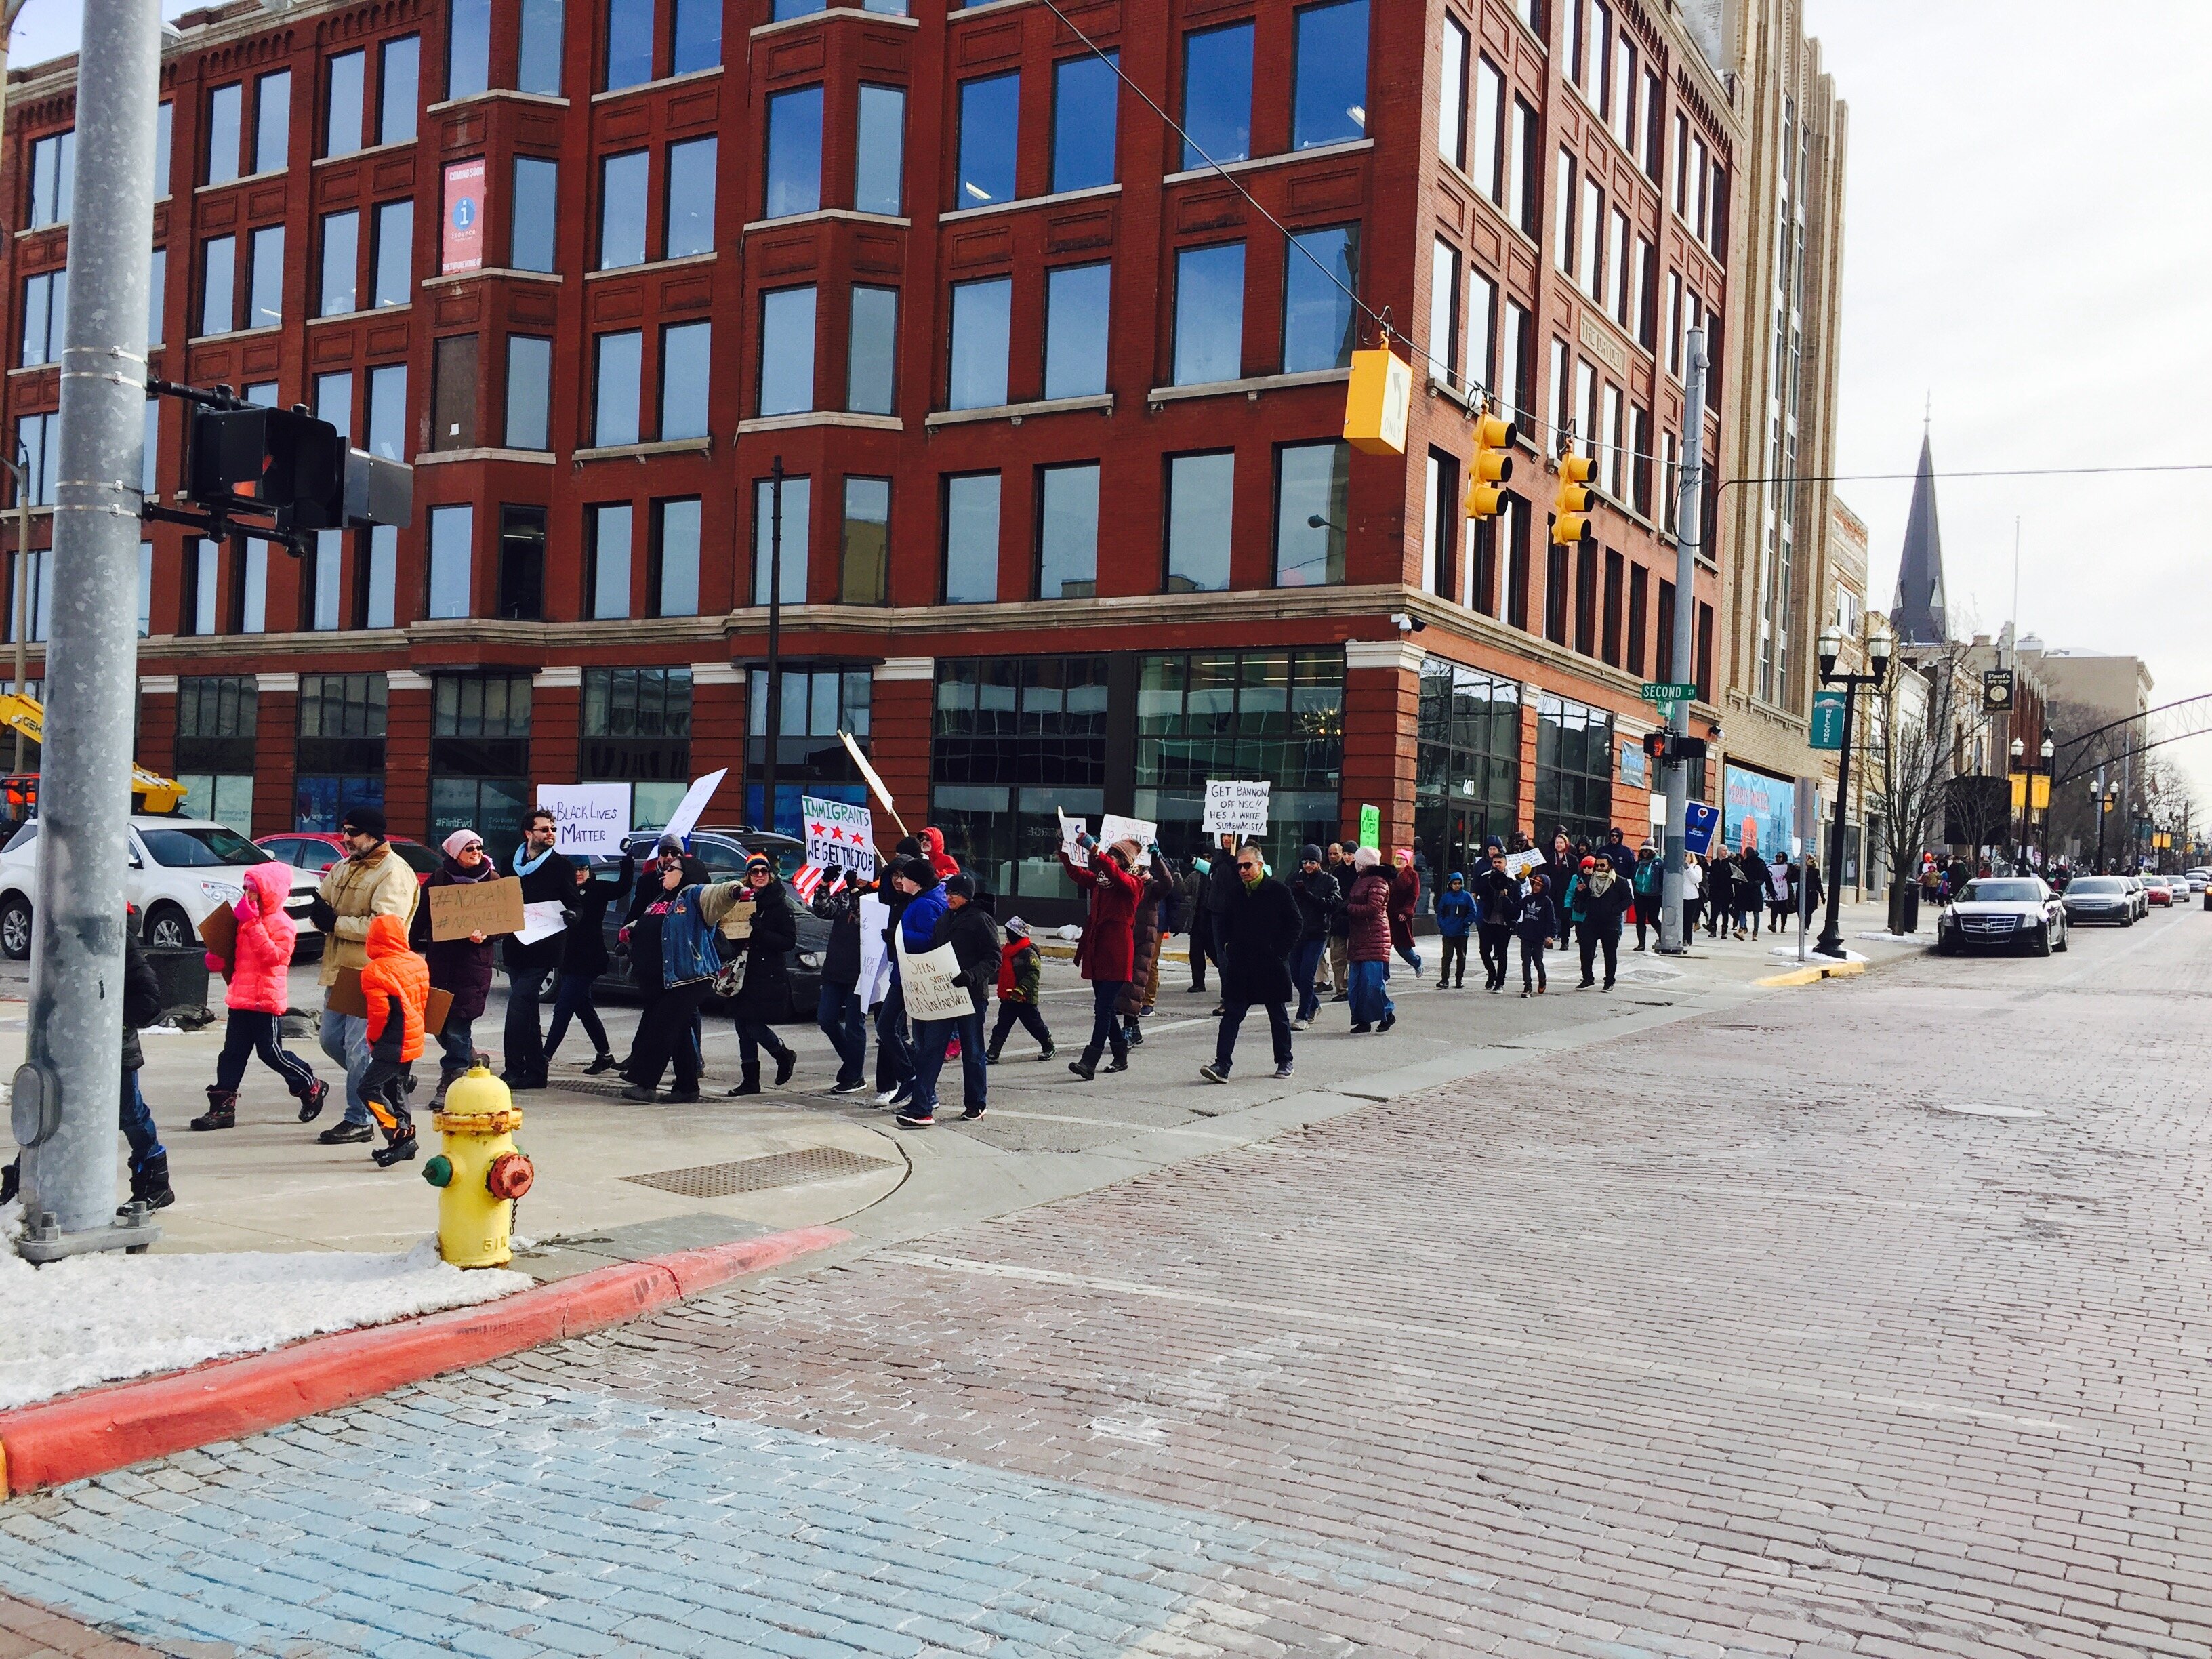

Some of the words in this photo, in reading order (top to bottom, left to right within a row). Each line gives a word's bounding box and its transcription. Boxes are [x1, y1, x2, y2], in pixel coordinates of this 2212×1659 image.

[449, 169, 470, 181] COMING
[470, 166, 484, 177] SOON
[1582, 319, 1595, 346] THE
[1597, 334, 1622, 371] DRYDEN
[1385, 417, 1402, 441] ONLY
[1643, 685, 1681, 698] SECOND
[23, 716, 43, 735] GEH
[1823, 708, 1832, 743] WELCOME
[1211, 785, 1231, 798] GET
[1237, 786, 1267, 798] BANNON
[1463, 779, 1474, 796] 601
[590, 801, 617, 820] LIVES
[803, 798, 869, 826] IMMIGRANTS
[1210, 810, 1227, 819] HE'S
[1221, 800, 1235, 808] OFF
[1239, 800, 1262, 811] NSC!!
[436, 817, 472, 827] #FlintFwd
[1124, 821, 1148, 832] NICE
[1216, 821, 1263, 833] SUPREMACIST!
[562, 823, 606, 844] MATTER
[807, 838, 820, 860] WE
[822, 842, 840, 864] GET
[840, 846, 854, 867] THE
[855, 850, 873, 872] JOB
[432, 882, 507, 908] #NOBAN
[436, 910, 512, 929] #NOWALL
[1525, 912, 1539, 921] adidas
[907, 956, 936, 975] SEEN
